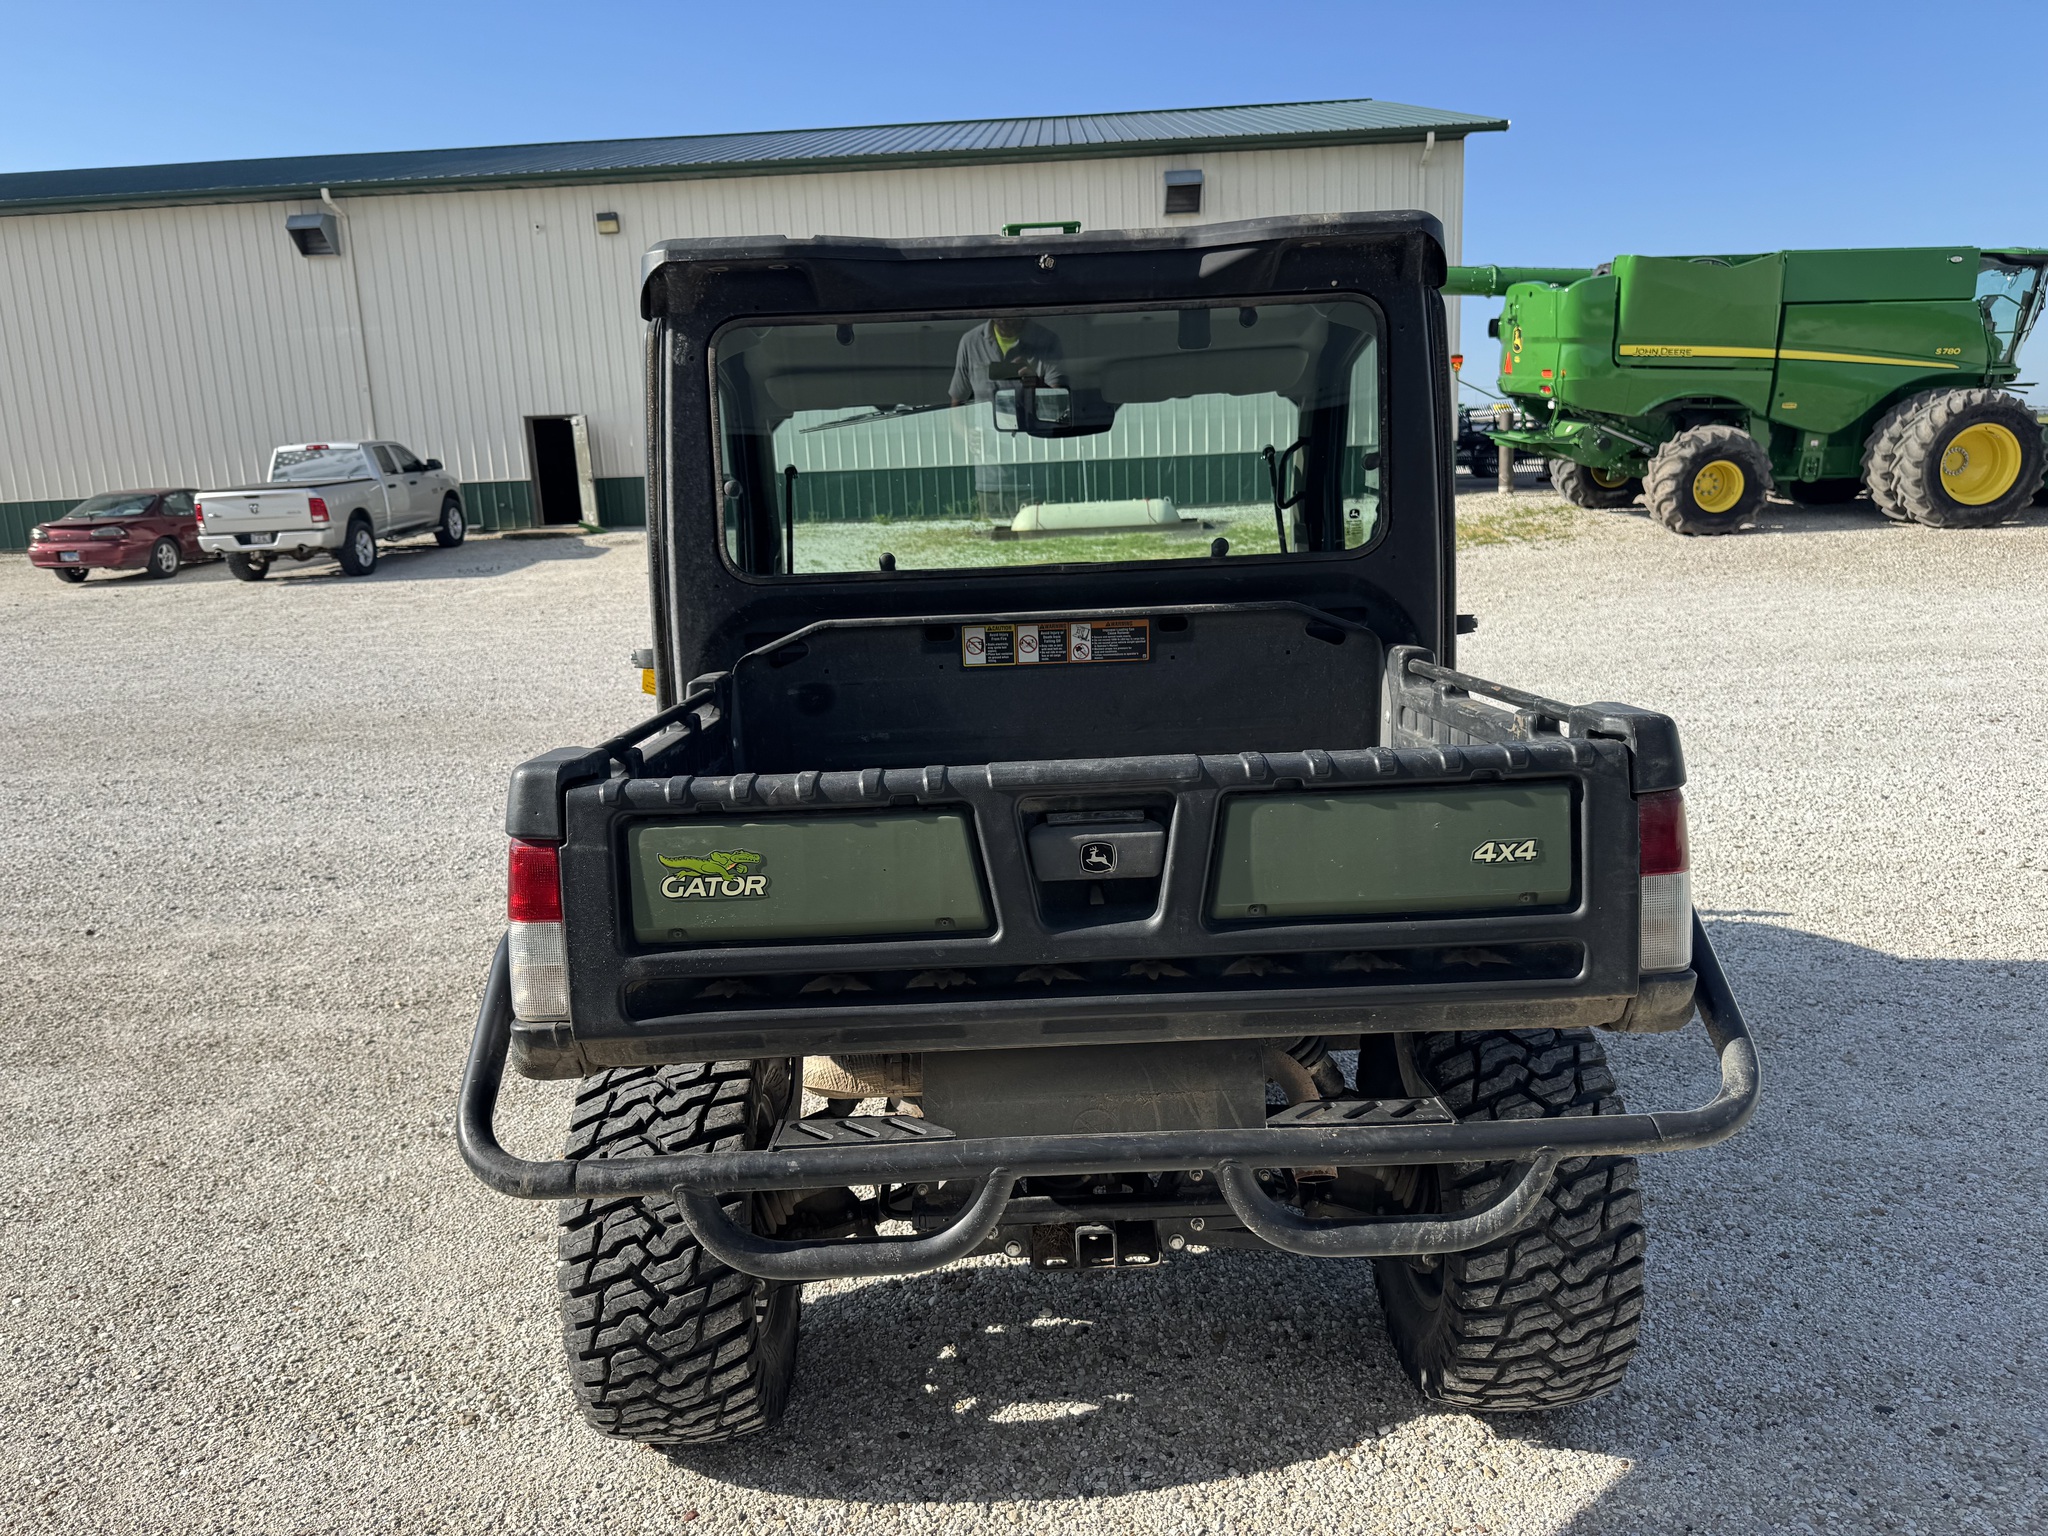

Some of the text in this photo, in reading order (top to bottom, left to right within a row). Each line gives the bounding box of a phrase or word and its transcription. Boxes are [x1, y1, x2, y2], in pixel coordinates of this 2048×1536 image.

[1632, 347, 1693, 357] JOHN DEERE
[661, 874, 766, 898] GATOR
